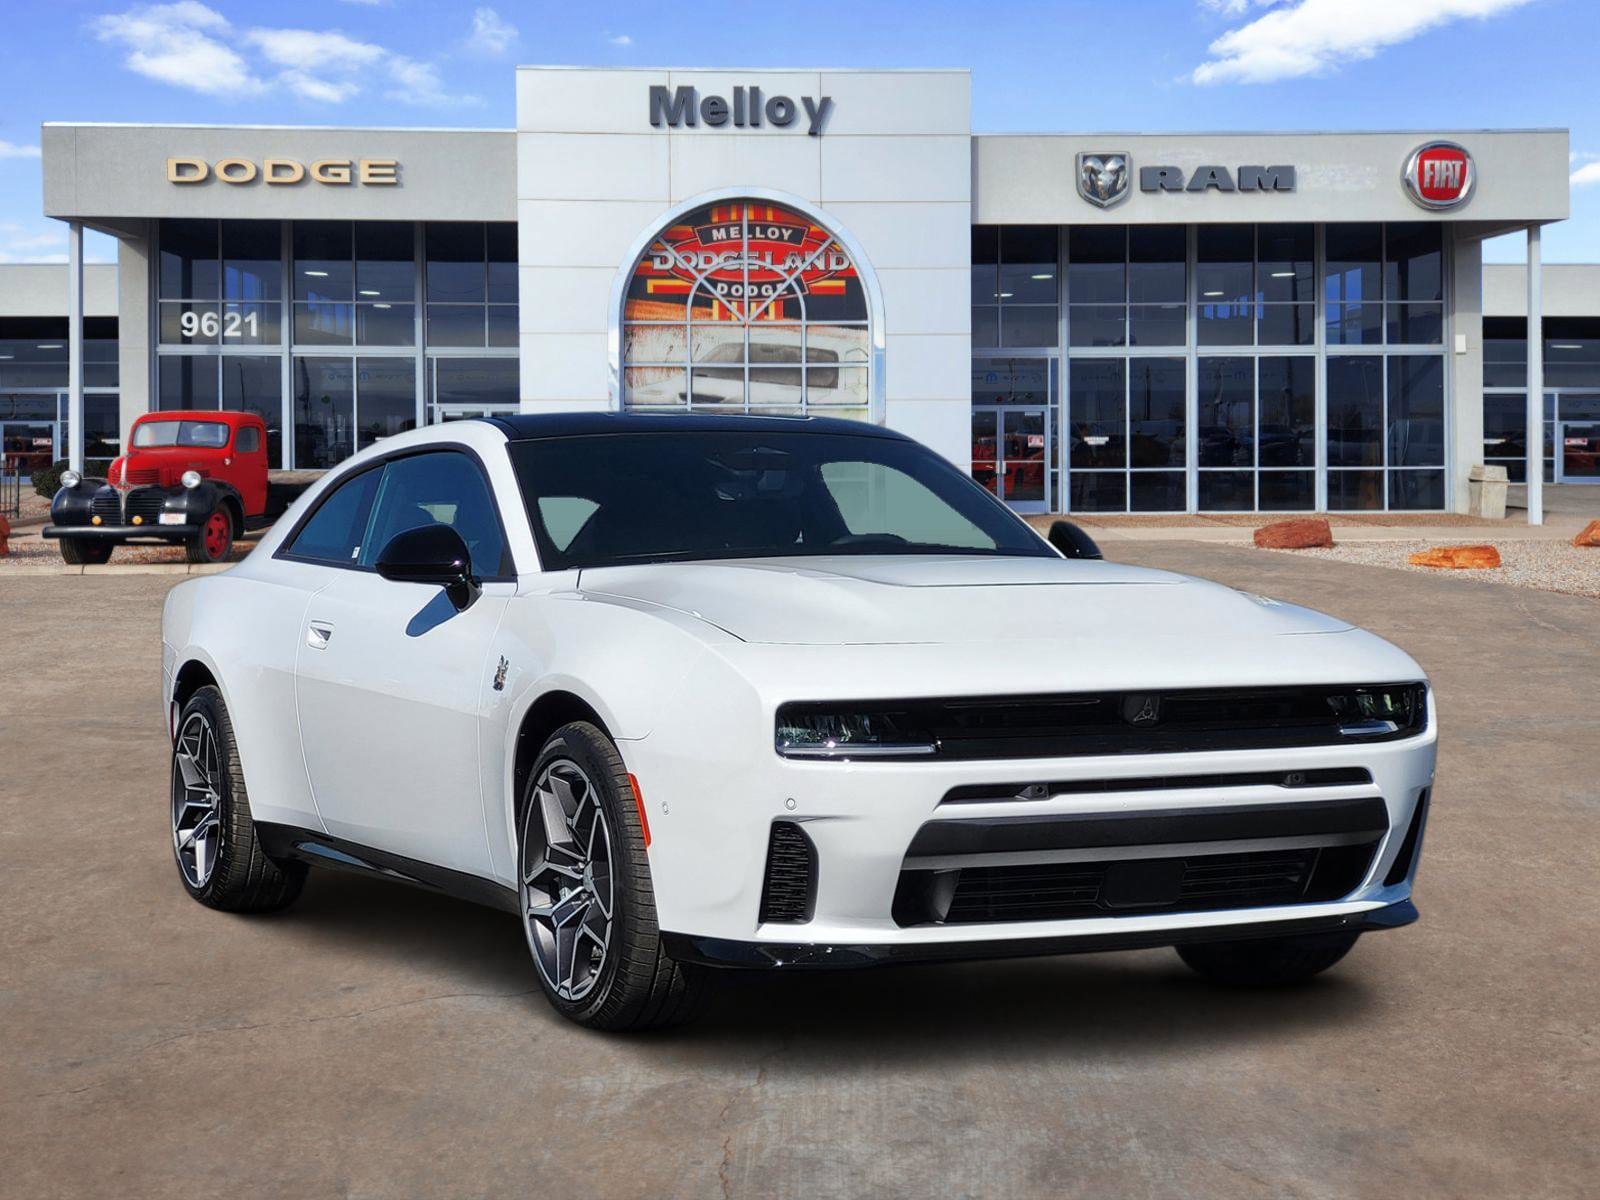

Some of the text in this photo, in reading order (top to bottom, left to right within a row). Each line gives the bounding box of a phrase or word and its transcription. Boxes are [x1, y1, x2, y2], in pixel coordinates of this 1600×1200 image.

[649, 85, 832, 136] Melloy
[167, 157, 398, 186] DODGE
[1139, 164, 1297, 193] RAM
[1423, 159, 1464, 189] FIAT
[180, 311, 258, 337] 9621
